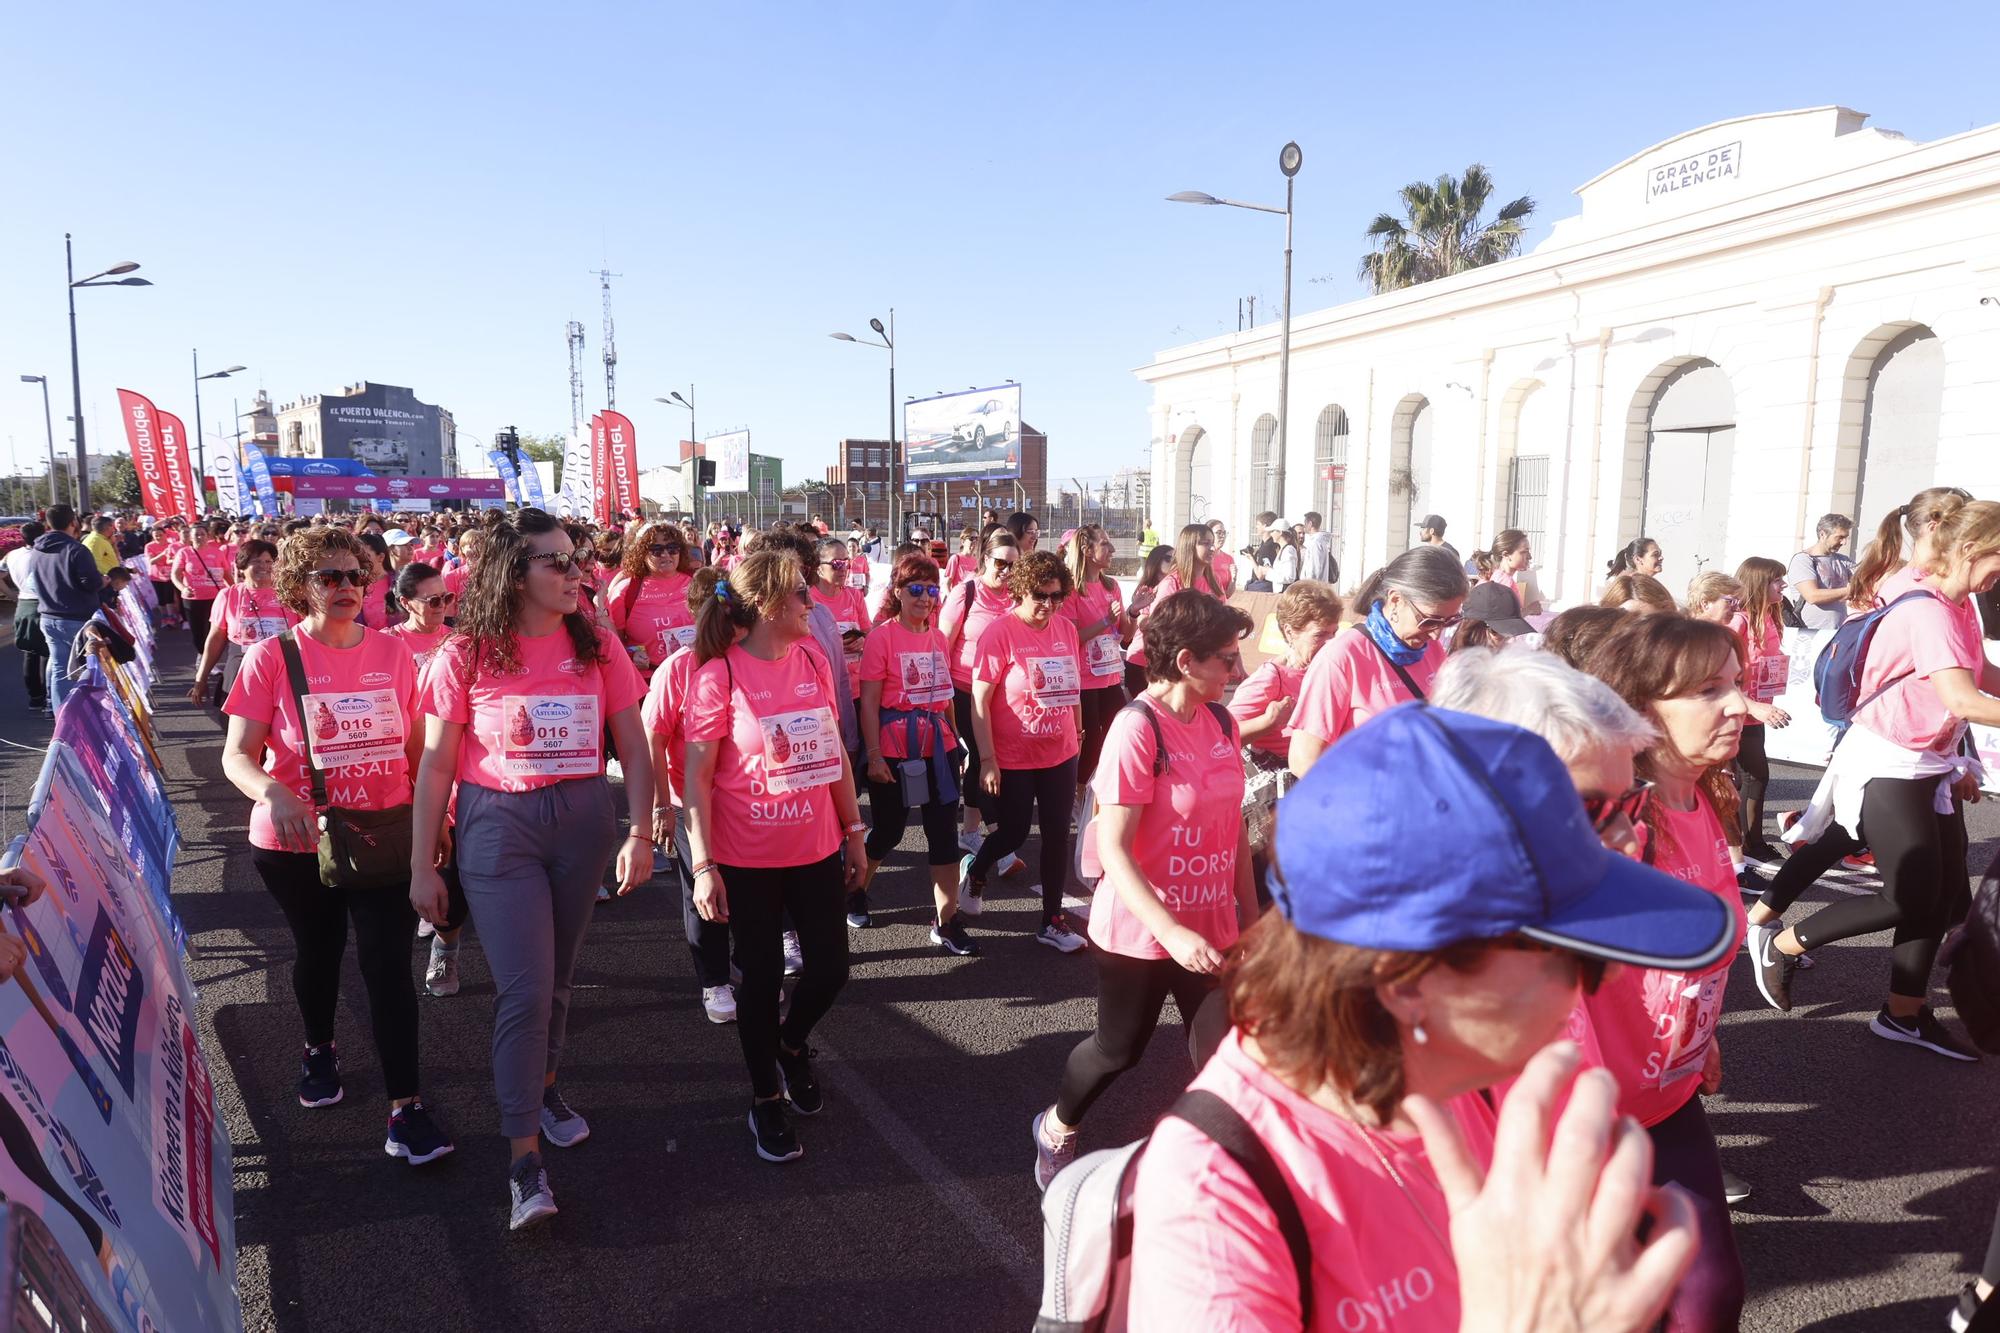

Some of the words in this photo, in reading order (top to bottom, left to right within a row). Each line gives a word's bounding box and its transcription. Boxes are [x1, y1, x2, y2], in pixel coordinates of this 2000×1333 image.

[1656, 160, 1699, 181] GRAO
[1708, 149, 1732, 166] DE
[1652, 163, 1733, 196] VALENCIA
[329, 407, 339, 415] EL
[653, 616, 671, 627] TU
[1047, 676, 1064, 684] 016
[336, 703, 370, 712] ASTURIANA
[535, 709, 569, 717] ASTURIANA
[341, 718, 373, 731] 016
[790, 723, 817, 733] ASTURIANA
[348, 731, 368, 740] 5609
[537, 726, 569, 739] 016
[543, 740, 563, 748] 5607
[792, 740, 818, 753] 016
[321, 754, 349, 763] OYSHO
[797, 753, 813, 762] 5610
[775, 778, 798, 786] OYSHO
[300, 784, 369, 803] SMA
[750, 799, 814, 820] SUMA
[1172, 827, 1201, 847] TU
[1169, 848, 1237, 877] DORSA
[1166, 879, 1229, 906] SUMA
[166, 1080, 181, 1105] a
[158, 1097, 187, 1233] Kilómetro
